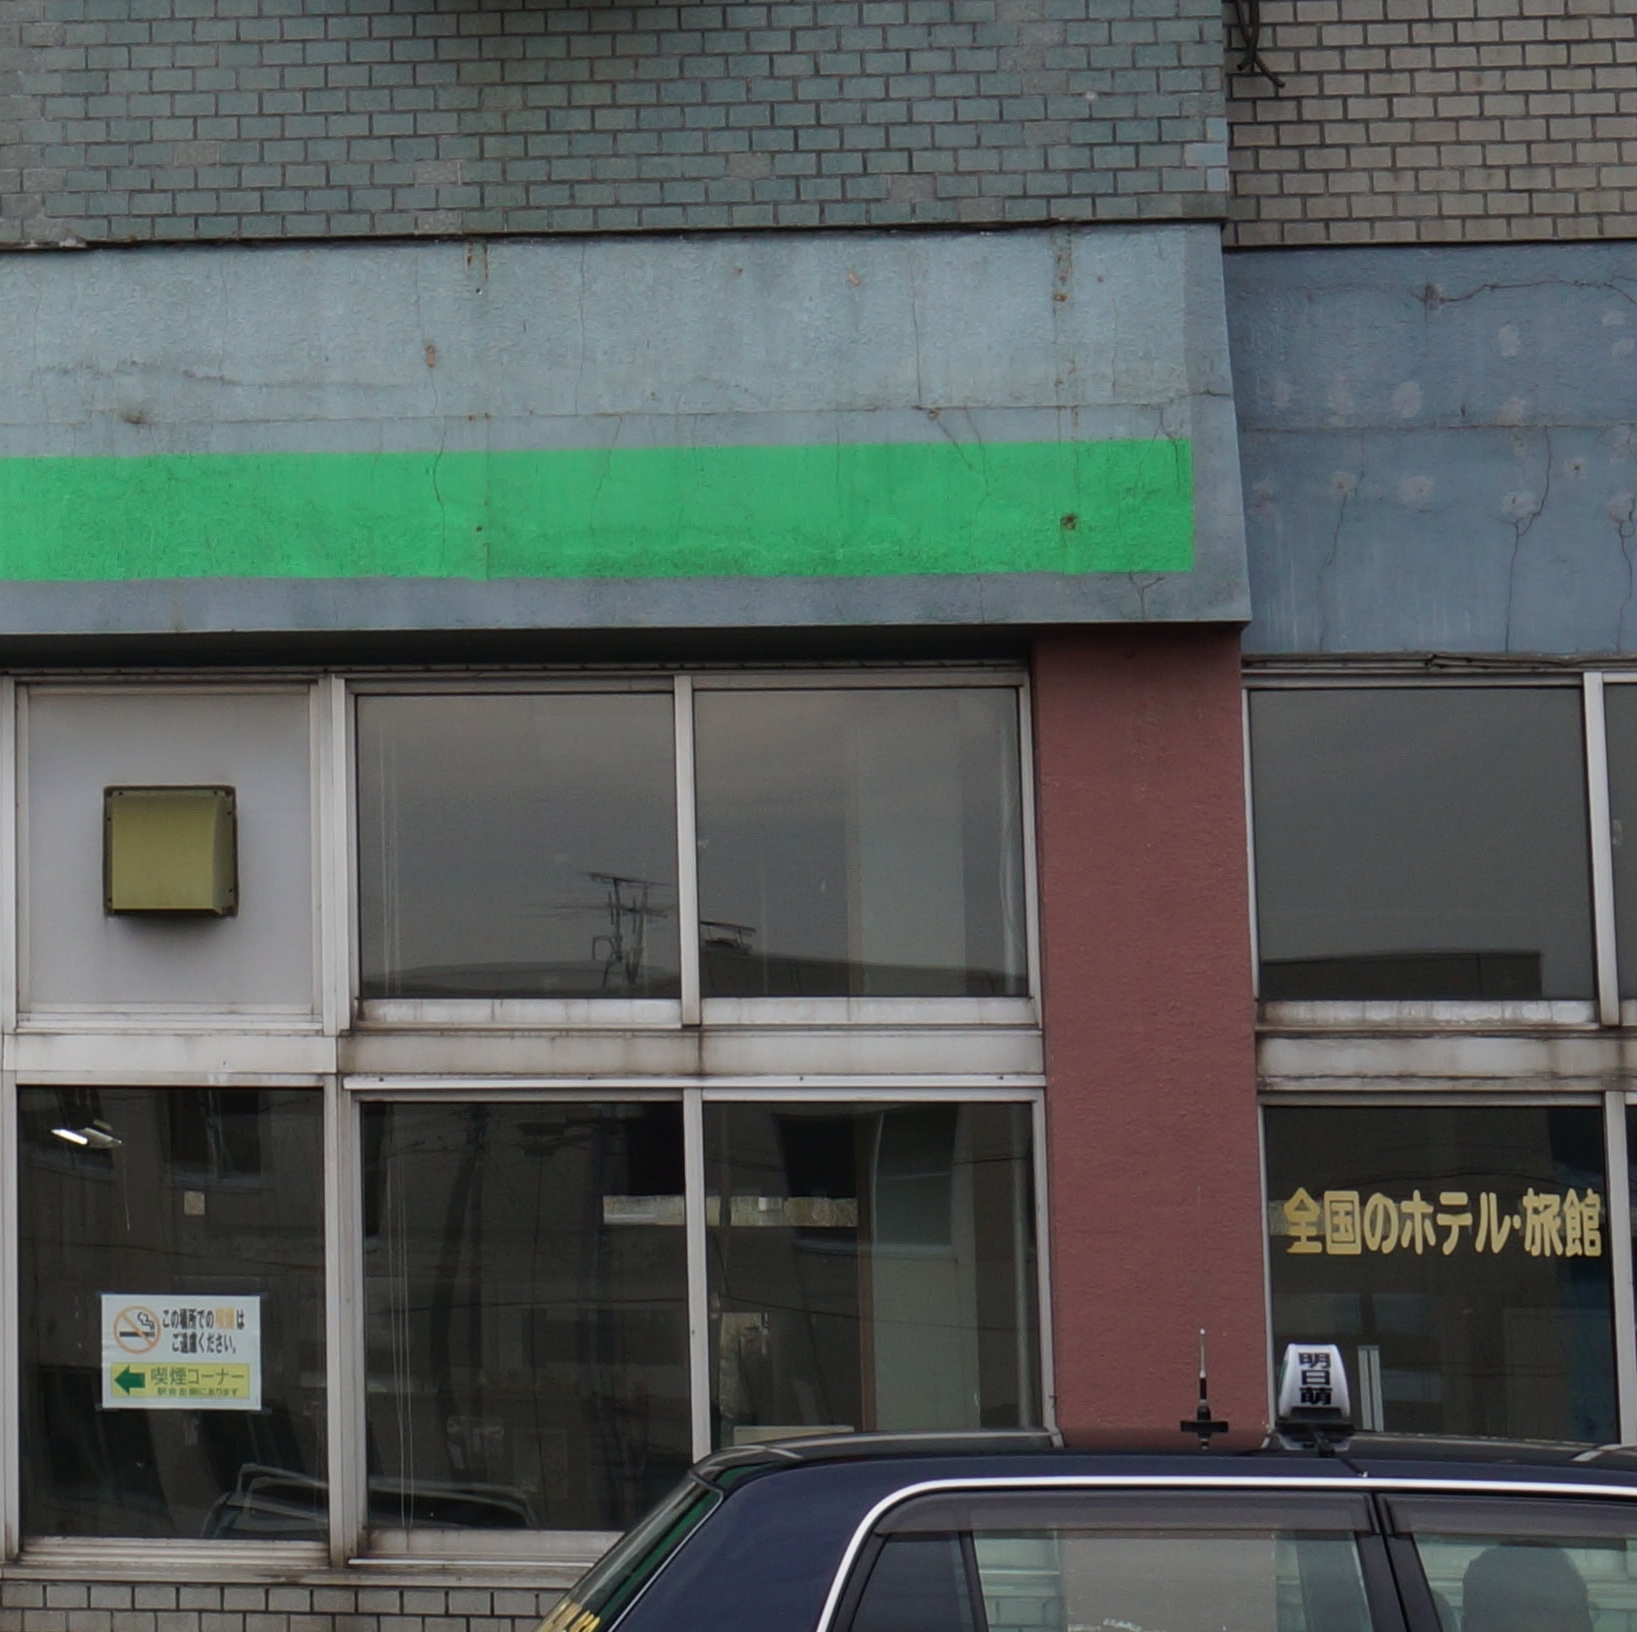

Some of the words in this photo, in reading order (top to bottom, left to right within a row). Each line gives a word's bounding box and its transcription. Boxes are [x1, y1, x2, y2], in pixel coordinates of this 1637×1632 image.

[1283, 1187, 1602, 1257] 全国のホテル・旅館
[162, 1308, 245, 1330] この場所でのは
[150, 1367, 245, 1386] 喫煙コーナー
[1297, 1352, 1333, 1406] 明日萌
